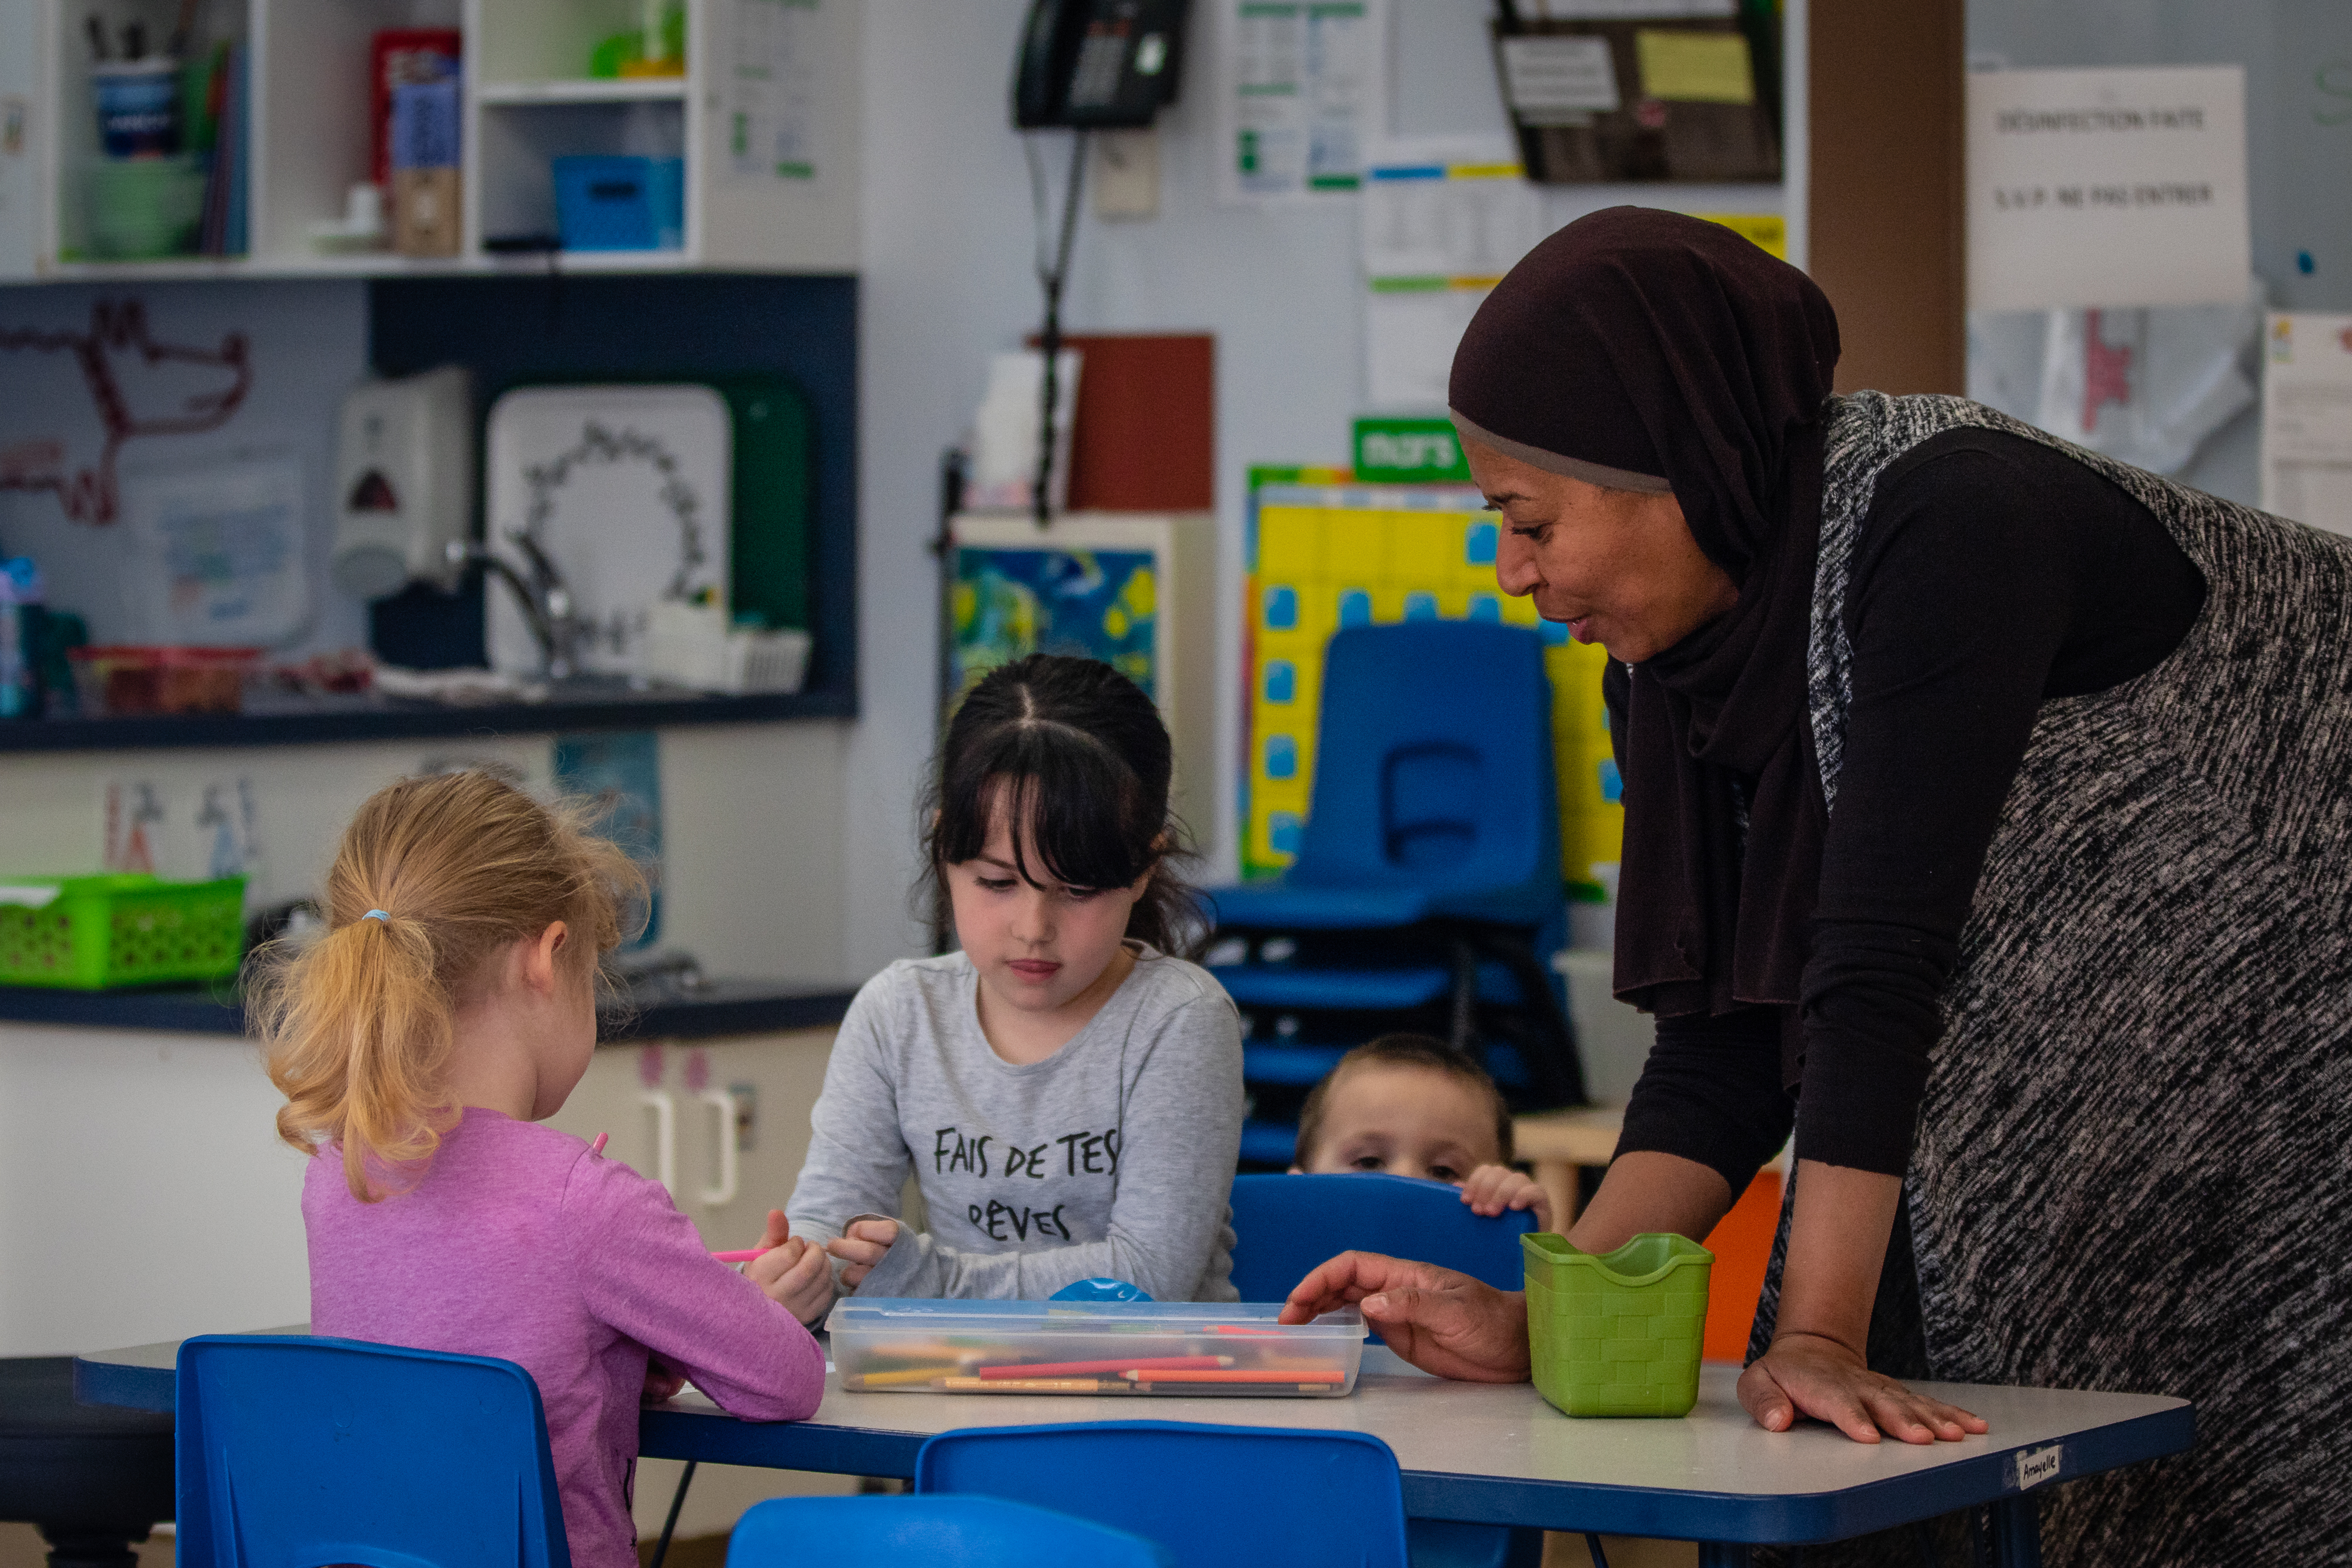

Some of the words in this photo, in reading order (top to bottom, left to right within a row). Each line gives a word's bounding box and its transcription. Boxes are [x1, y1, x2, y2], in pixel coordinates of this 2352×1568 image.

[934, 1127, 993, 1178] FAIS
[1004, 1144, 1048, 1179] DE
[1056, 1128, 1117, 1176] TES
[2023, 1455, 2056, 1480] Amayelle
